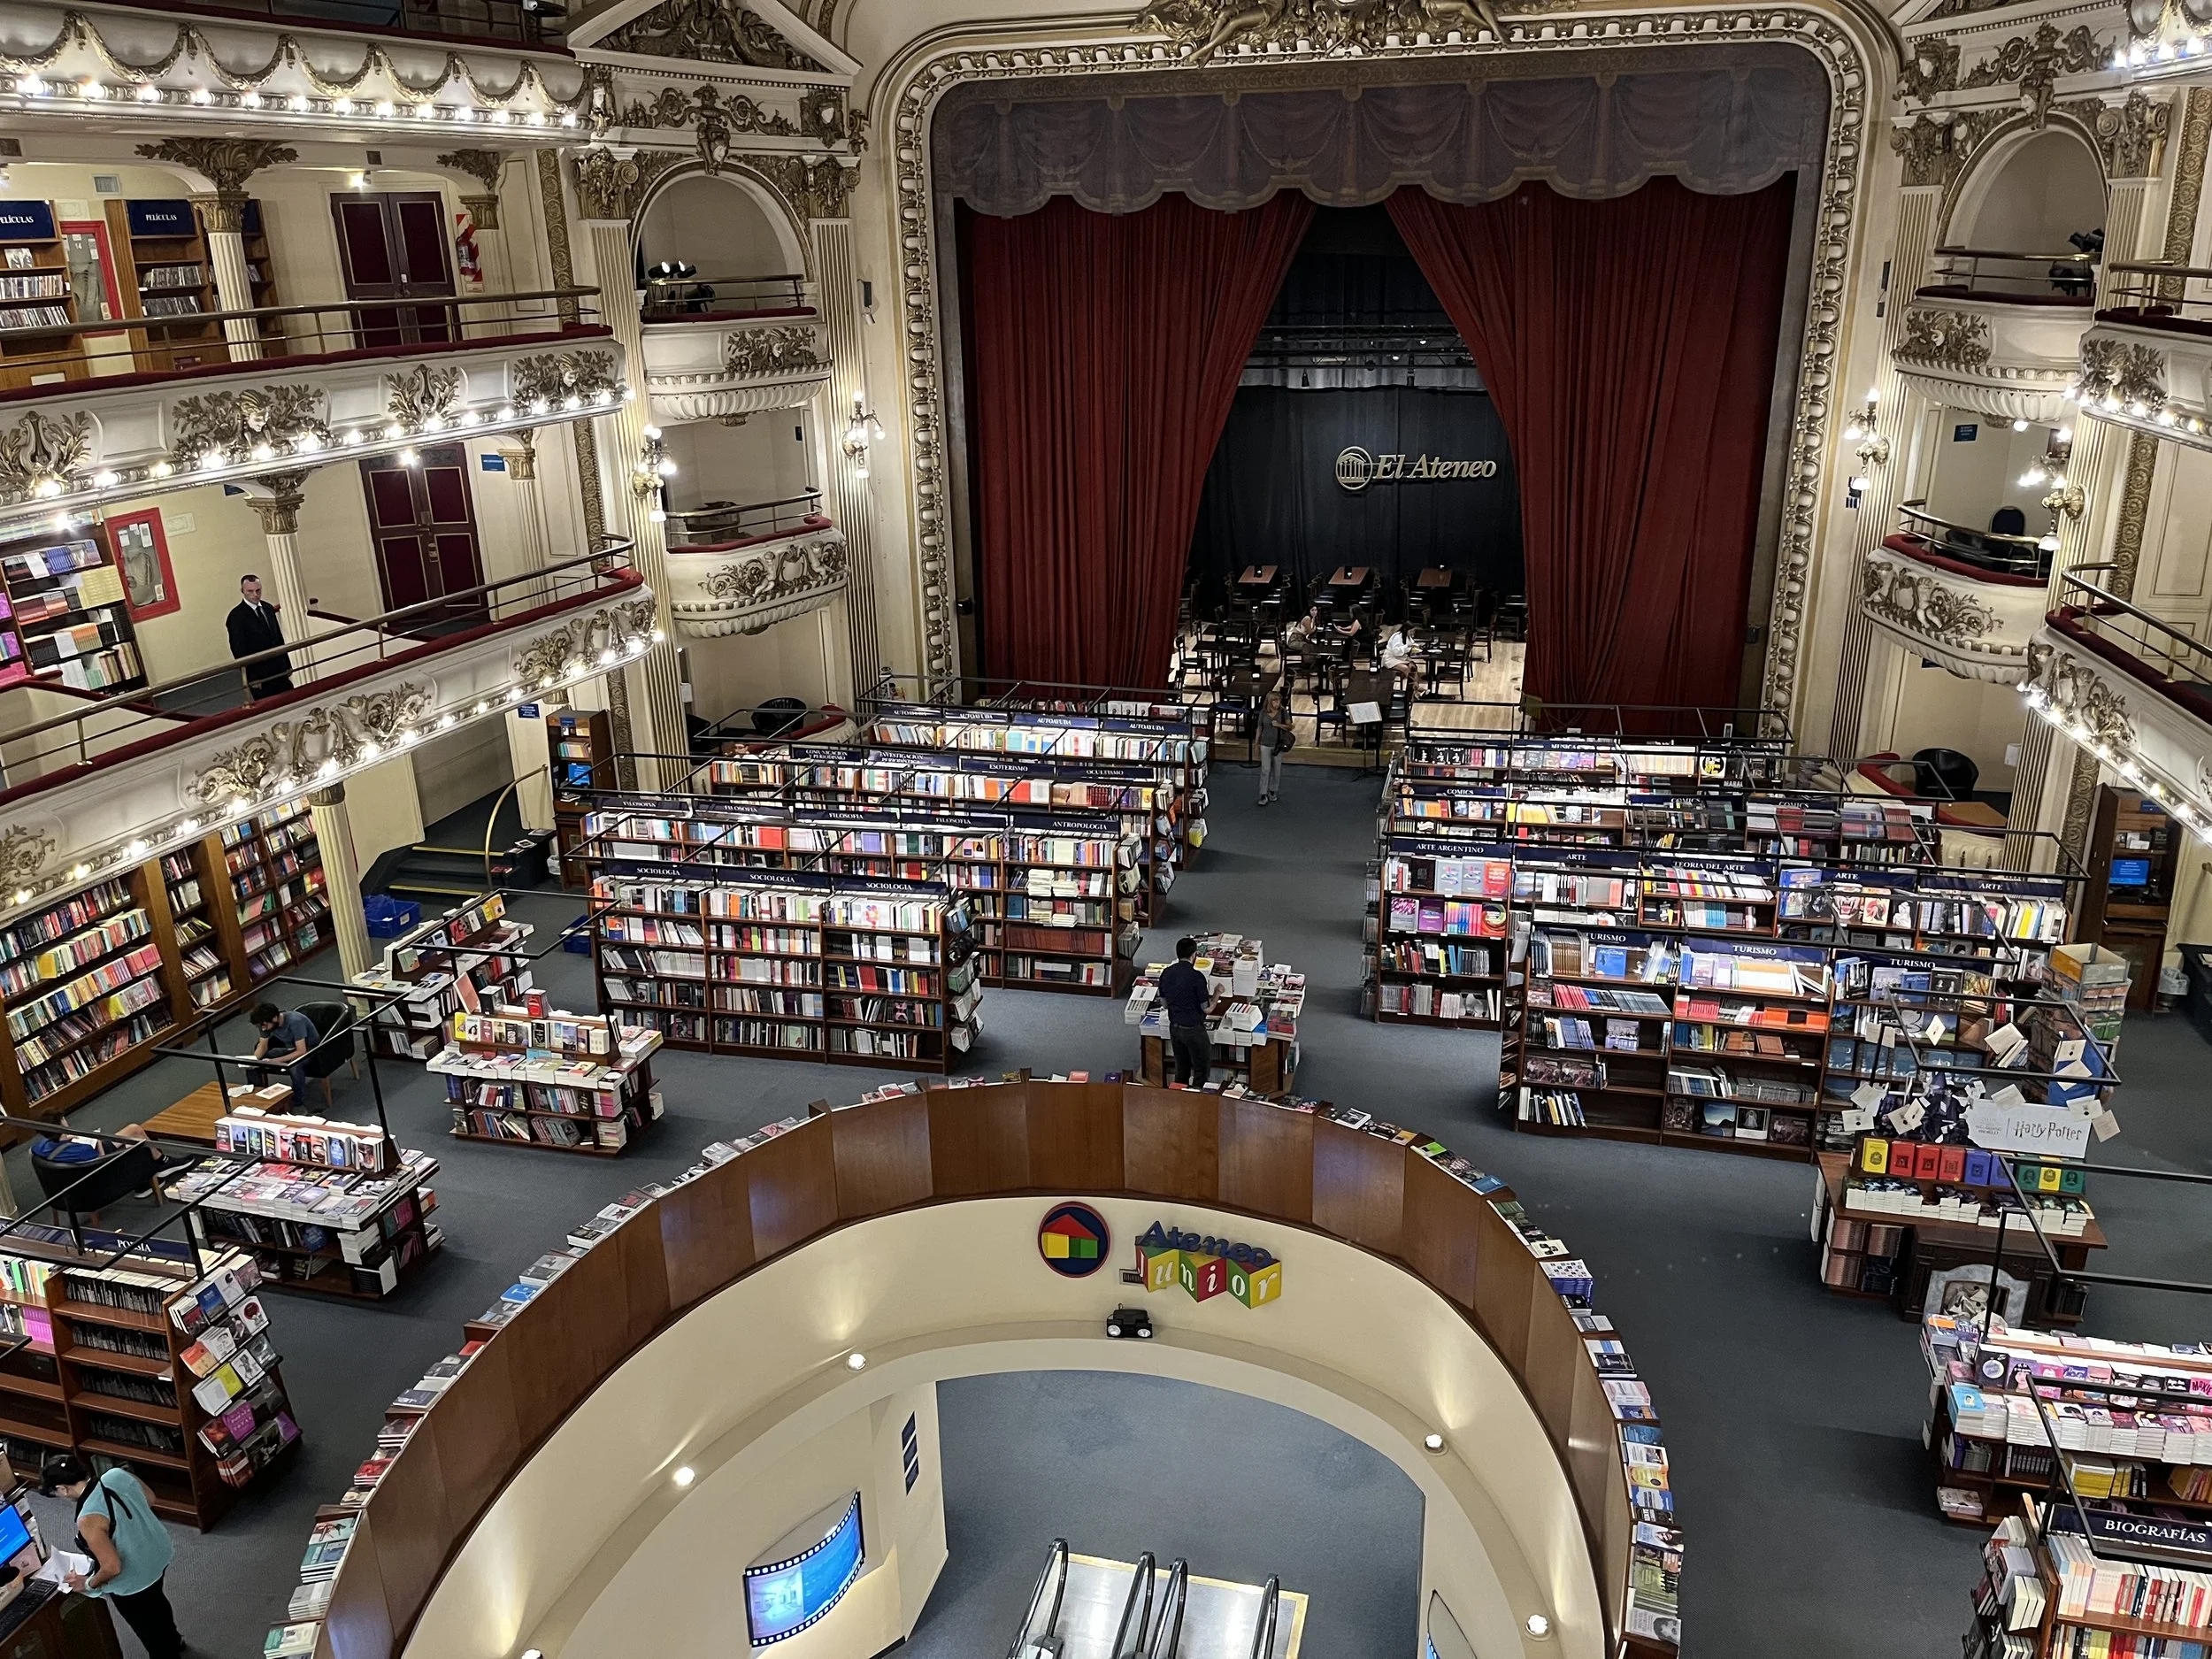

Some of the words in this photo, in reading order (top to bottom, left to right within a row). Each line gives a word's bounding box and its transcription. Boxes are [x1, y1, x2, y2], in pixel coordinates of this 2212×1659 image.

[1376, 454, 1405, 480] El
[1409, 453, 1497, 480] Ateneo
[1129, 723, 1165, 732] AUTOAYUDA
[1052, 821, 1108, 830] ANTROPOLOGIA
[1437, 845, 1484, 854] ARGENTINO
[636, 867, 680, 876] SOCIOLOGIA
[749, 873, 795, 883] SOCIOLOGIA
[865, 882, 912, 891] SOCIOLOGIA
[1732, 945, 1778, 956] TURISMO
[1890, 958, 1936, 969] TURISMO
[2014, 1120, 2047, 1139] Harry
[2047, 1121, 2082, 1141] Potter
[1138, 1220, 1272, 1269] Ateneo
[2104, 1519, 2207, 1544] BIOGRAFÍAS
